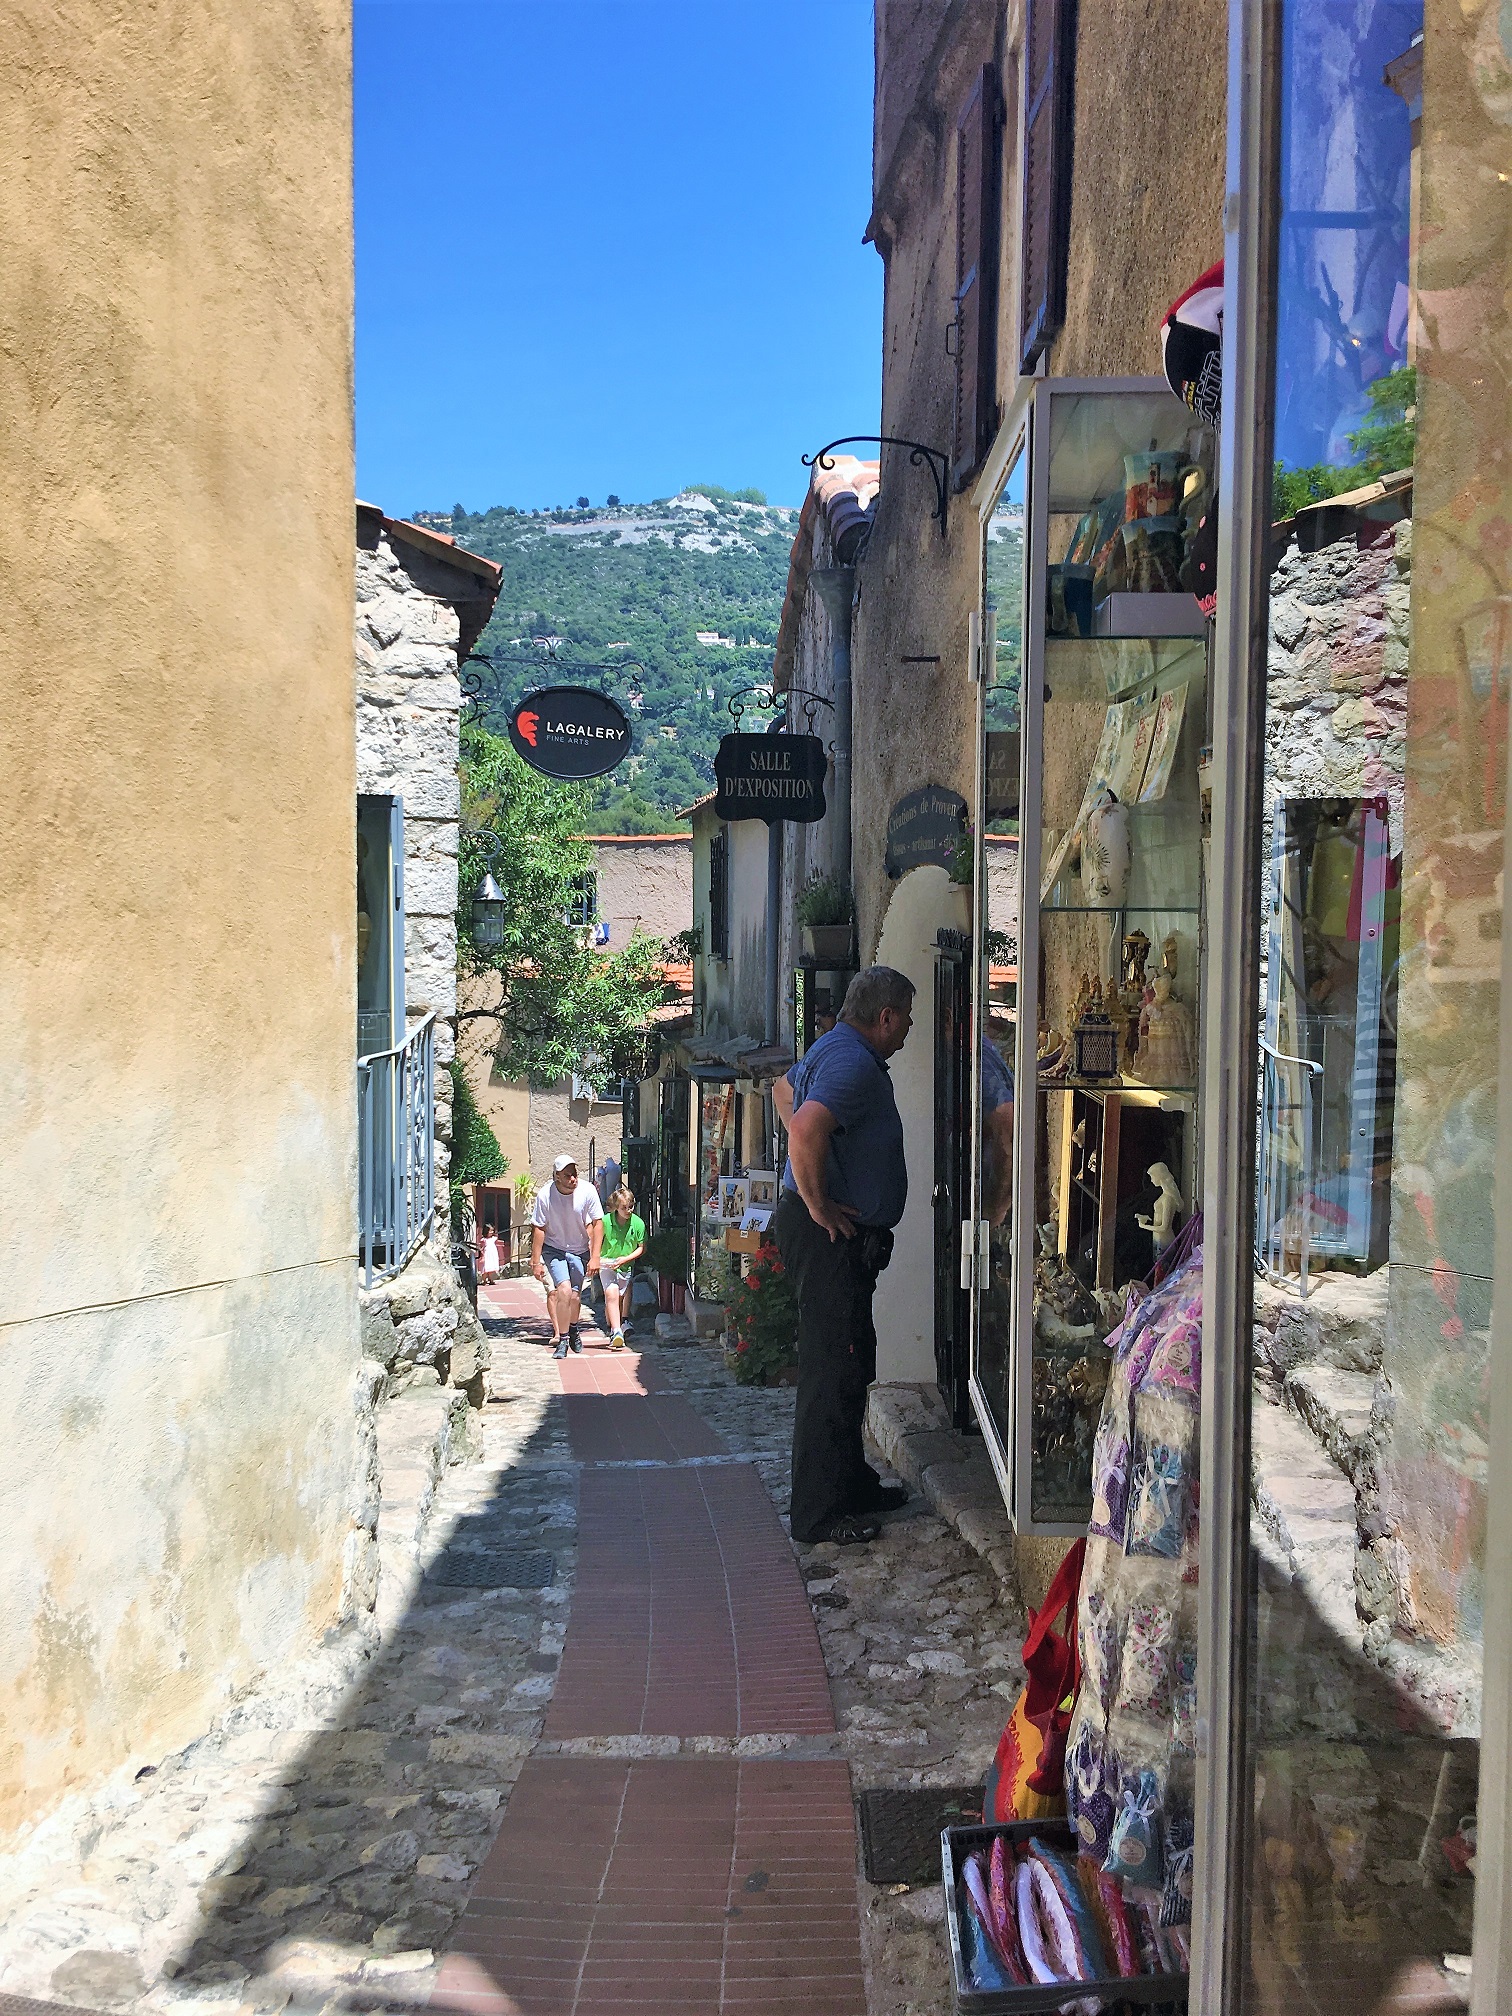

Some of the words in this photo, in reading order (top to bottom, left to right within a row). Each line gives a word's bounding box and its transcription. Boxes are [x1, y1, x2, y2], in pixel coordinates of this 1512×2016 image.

[546, 721, 625, 741] LAGALERY
[546, 734, 565, 743] FINE
[567, 737, 590, 746] ARTS
[750, 751, 791, 771] SALLE
[724, 777, 814, 799] D'EXPOSITION
[920, 797, 929, 814] de
